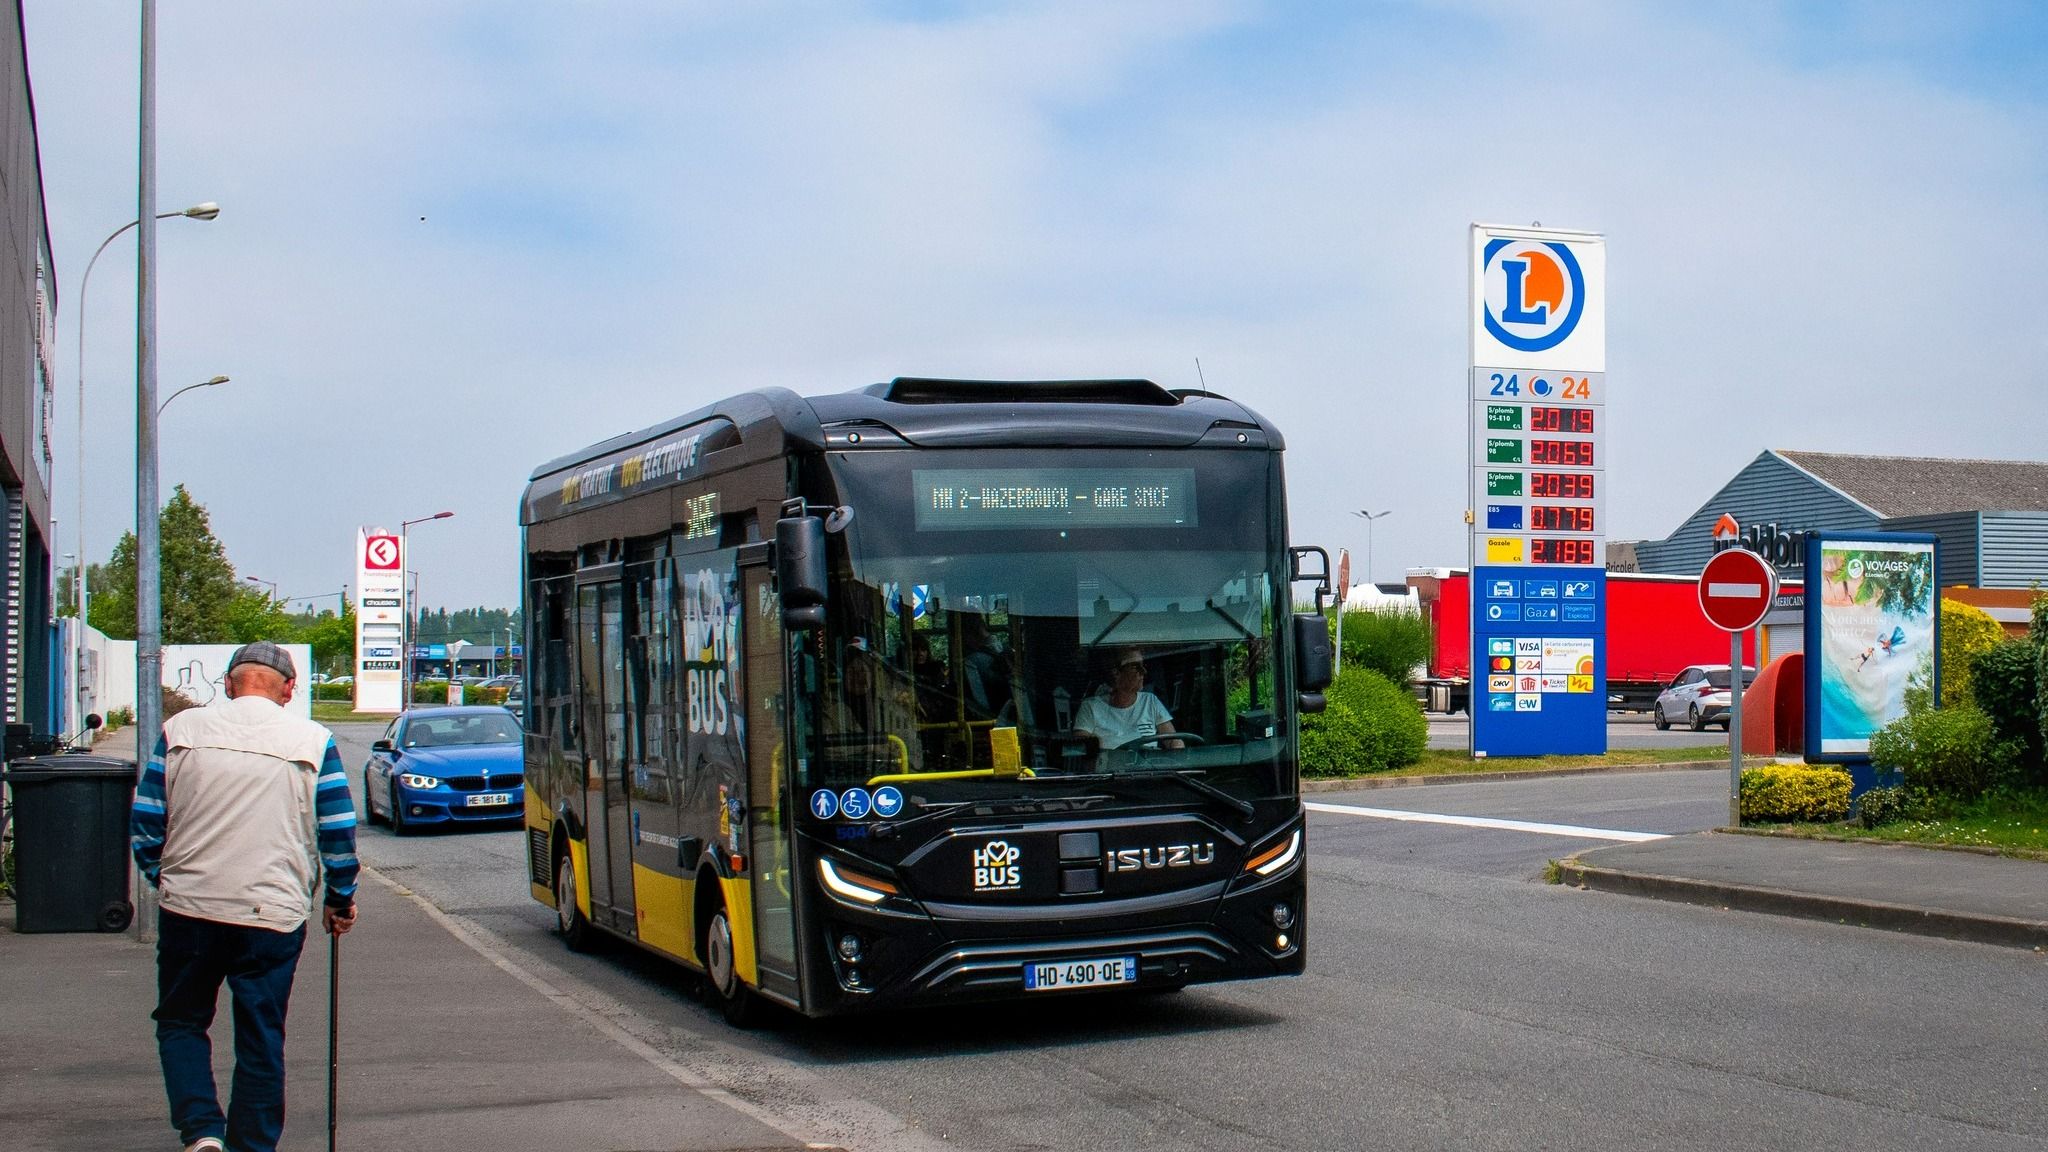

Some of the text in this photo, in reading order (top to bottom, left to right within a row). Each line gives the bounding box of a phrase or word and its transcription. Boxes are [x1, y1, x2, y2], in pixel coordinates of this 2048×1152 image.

[1490, 373, 1590, 400] 24 24
[1094, 487, 1127, 508] GARE
[1134, 487, 1170, 508] SNCF
[1531, 473, 1593, 498] 2.039
[1531, 506, 1593, 531] 0.779
[1531, 539, 1593, 564] 2.189
[1865, 559, 1909, 572] VOYAGES
[1526, 607, 1548, 618] Gaz
[1518, 642, 1540, 651] VISA
[688, 669, 727, 736] BUS
[1107, 843, 1214, 873] ISUZU
[975, 866, 1021, 887] BUS
